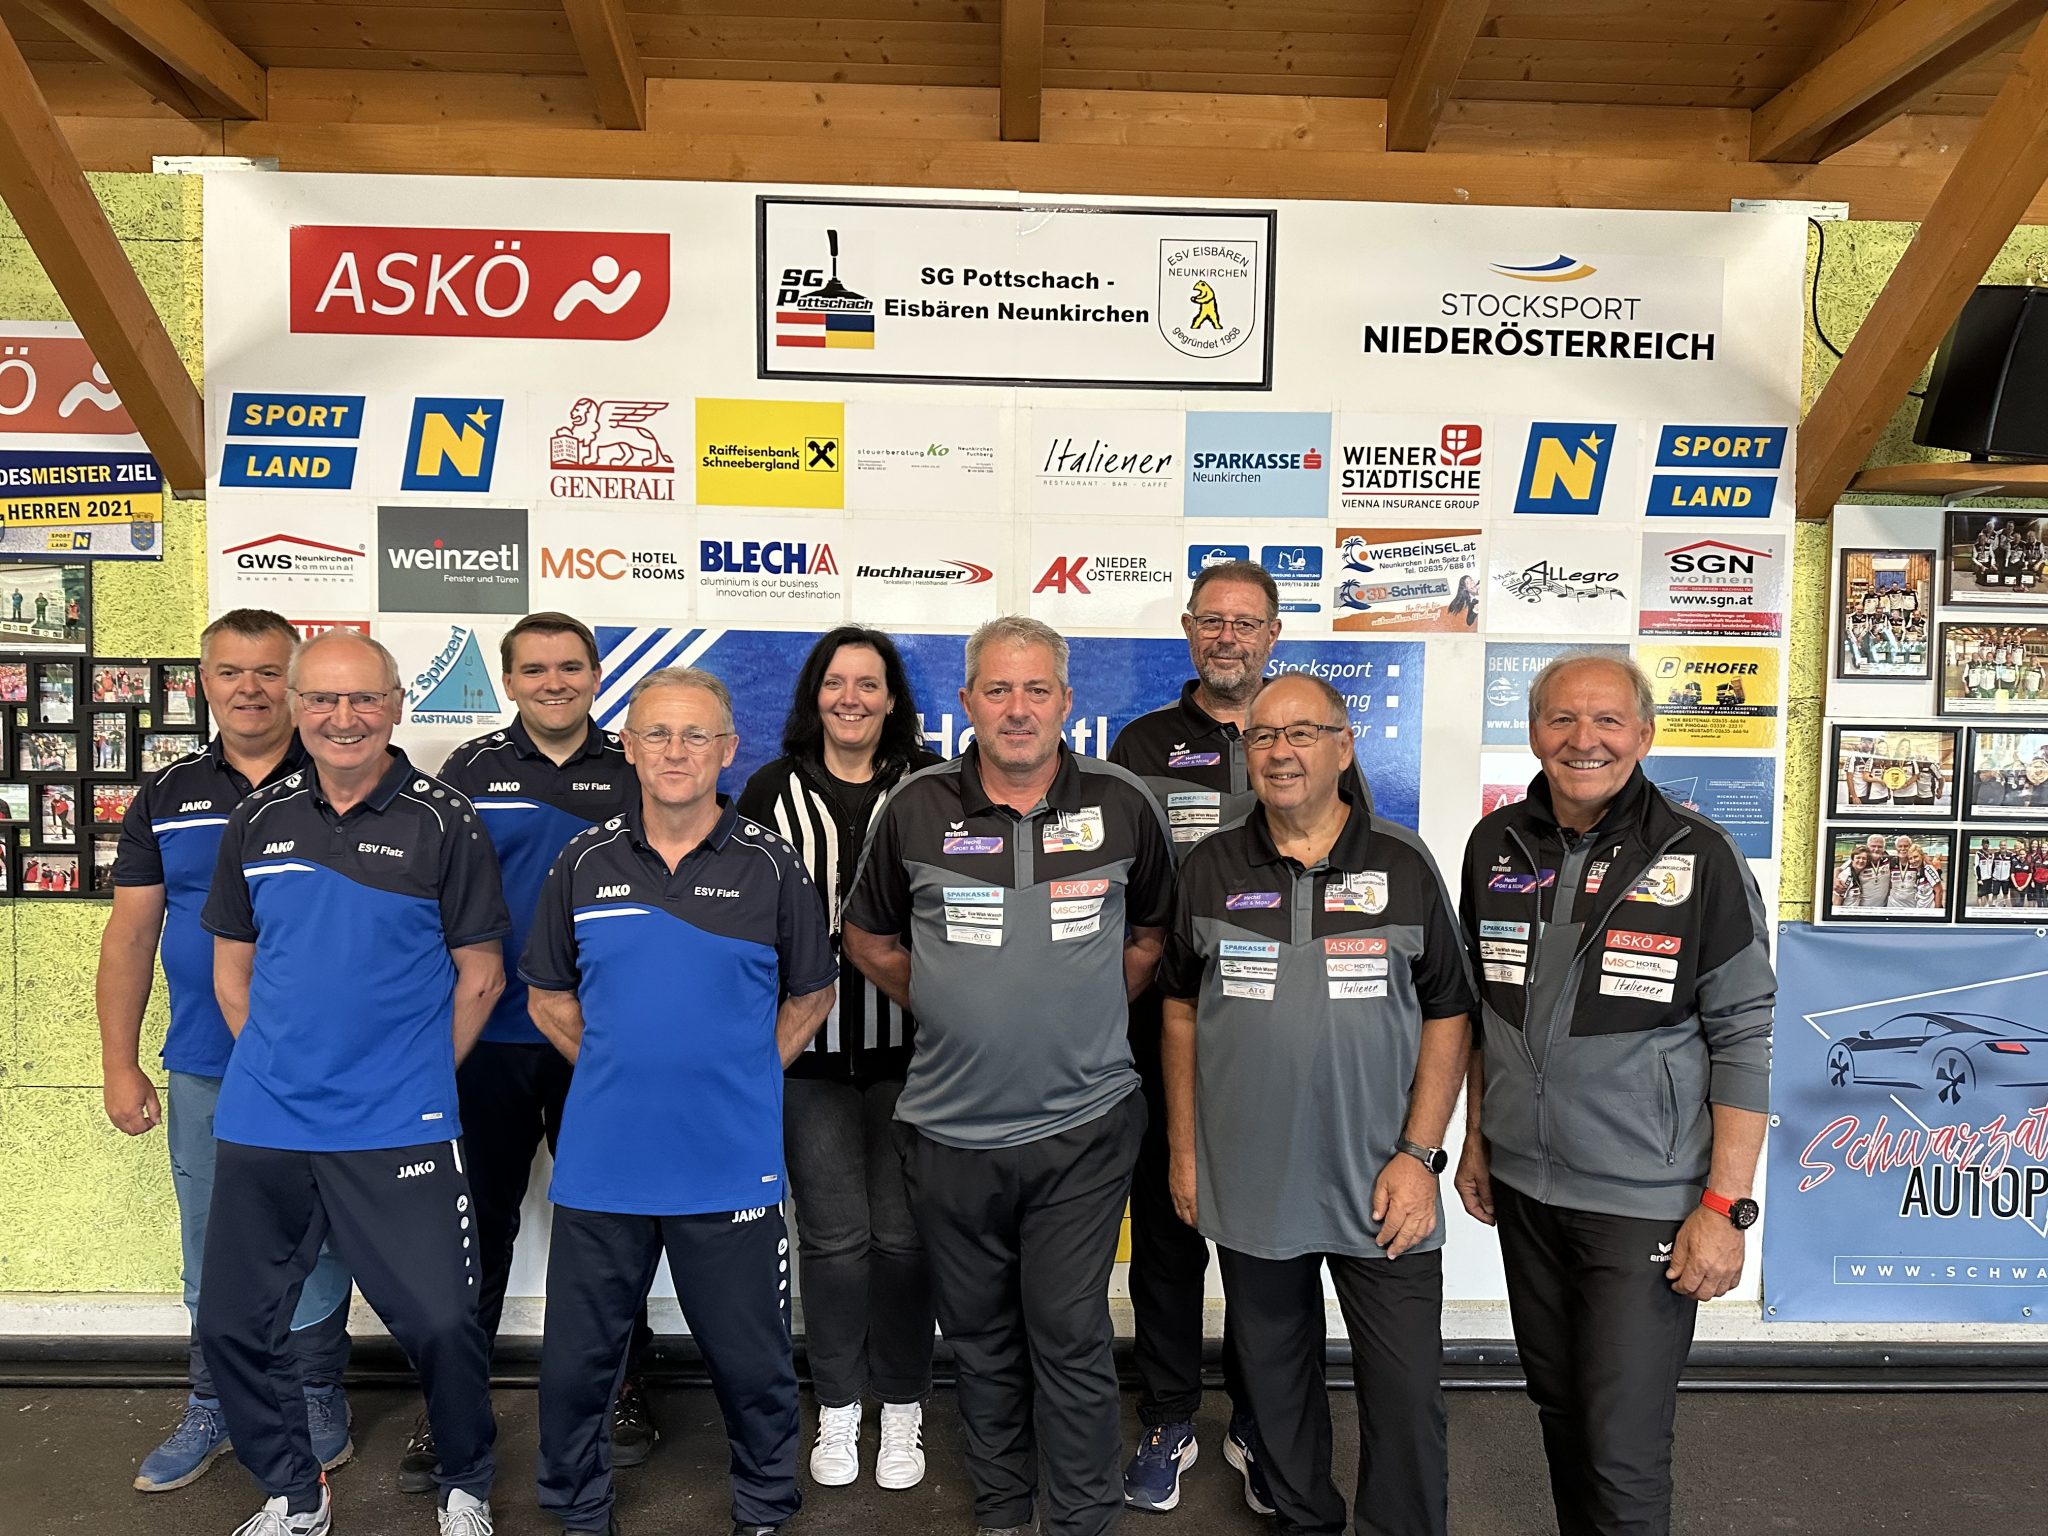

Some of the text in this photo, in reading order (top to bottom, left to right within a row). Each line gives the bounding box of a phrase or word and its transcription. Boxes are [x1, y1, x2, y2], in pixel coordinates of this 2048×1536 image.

[1166, 246, 1251, 268] ESV EISBÄREN
[315, 240, 530, 318] ASKÖ
[781, 268, 824, 287] SG
[920, 267, 955, 286] SG
[962, 268, 1100, 291] Pottschach
[1167, 267, 1248, 278] NEUNKIRCHEN
[776, 288, 874, 311] Pottschach
[1441, 292, 1642, 321] STOCKSPORT
[884, 299, 1150, 324] Eisbären Neunkirchen
[1172, 325, 1241, 350] gegründet 1958
[1363, 322, 1715, 361] NIEDERÖSTERREICH
[244, 404, 349, 428] SPORT
[708, 444, 800, 458] Raiffeisenbank
[1672, 436, 1772, 459] SPORT
[1044, 438, 1173, 474] Italiener
[1193, 453, 1301, 470] SPARKASSE
[1343, 446, 1437, 466] WIENER
[246, 455, 332, 479] LAND
[702, 456, 800, 472] Schneebergland
[116, 464, 157, 482] ZIEL
[1192, 471, 1261, 483] Neunkirchen
[1341, 468, 1481, 490] STÄDTISCHE
[550, 475, 675, 501] GENERALI
[1043, 479, 1099, 487] RESTAURANT
[1671, 485, 1752, 507] LAND
[8, 499, 134, 520] HERREN 2021
[1341, 498, 1480, 510] VIENNA INSURANCE GROUP
[237, 553, 354, 570] GWS Neunkirchen
[388, 538, 519, 572] weinzetl
[1379, 559, 1422, 570] Neunkirchen
[1428, 557, 1441, 565] Am
[1442, 555, 1460, 565] Spitz
[295, 563, 354, 571] kommunal
[541, 547, 678, 581] MSC HOTEL
[1670, 553, 1754, 574] SGN
[444, 574, 519, 585] Fenster und Türen
[632, 567, 685, 581] ROOMS
[856, 565, 965, 580] Hochhauser
[1032, 556, 1147, 595] AK NIEDER
[1086, 568, 1173, 583] ÖSTERREICH
[1670, 574, 1754, 584] wohnen
[700, 576, 819, 589] aluminium is our business
[715, 587, 841, 600] innovation our destination
[1669, 594, 1753, 608] www.sgn.at
[1266, 659, 1374, 682] Stocksport
[1489, 656, 1519, 672] BENE
[1684, 662, 1759, 675] PEHOFER
[411, 714, 473, 725] GASTHAUS
[1169, 749, 1191, 757] erima
[487, 781, 521, 792] JAKO
[572, 782, 611, 791] ESV Flatz
[178, 799, 212, 813] JAKO
[944, 830, 969, 838] erima
[262, 840, 295, 855] JAKO
[357, 842, 404, 858] ESV Flatz
[1491, 865, 1512, 873] erima
[596, 884, 631, 899] JAKO
[694, 886, 740, 899] ESV Flatz
[1054, 882, 1089, 896] ASKÖ
[1482, 925, 1517, 933] SPARKASSE
[1223, 944, 1267, 952] SPARKASSE
[1329, 939, 1365, 952] ASKÖ
[1610, 934, 1653, 949] ASKÖ
[1327, 963, 1354, 972] MSC
[1604, 956, 1661, 969] MSC HOTEL
[1339, 982, 1379, 994] Italiener
[1614, 978, 1664, 995] Italiener
[397, 1160, 436, 1179] JAKO
[731, 1206, 766, 1224] JAKO
